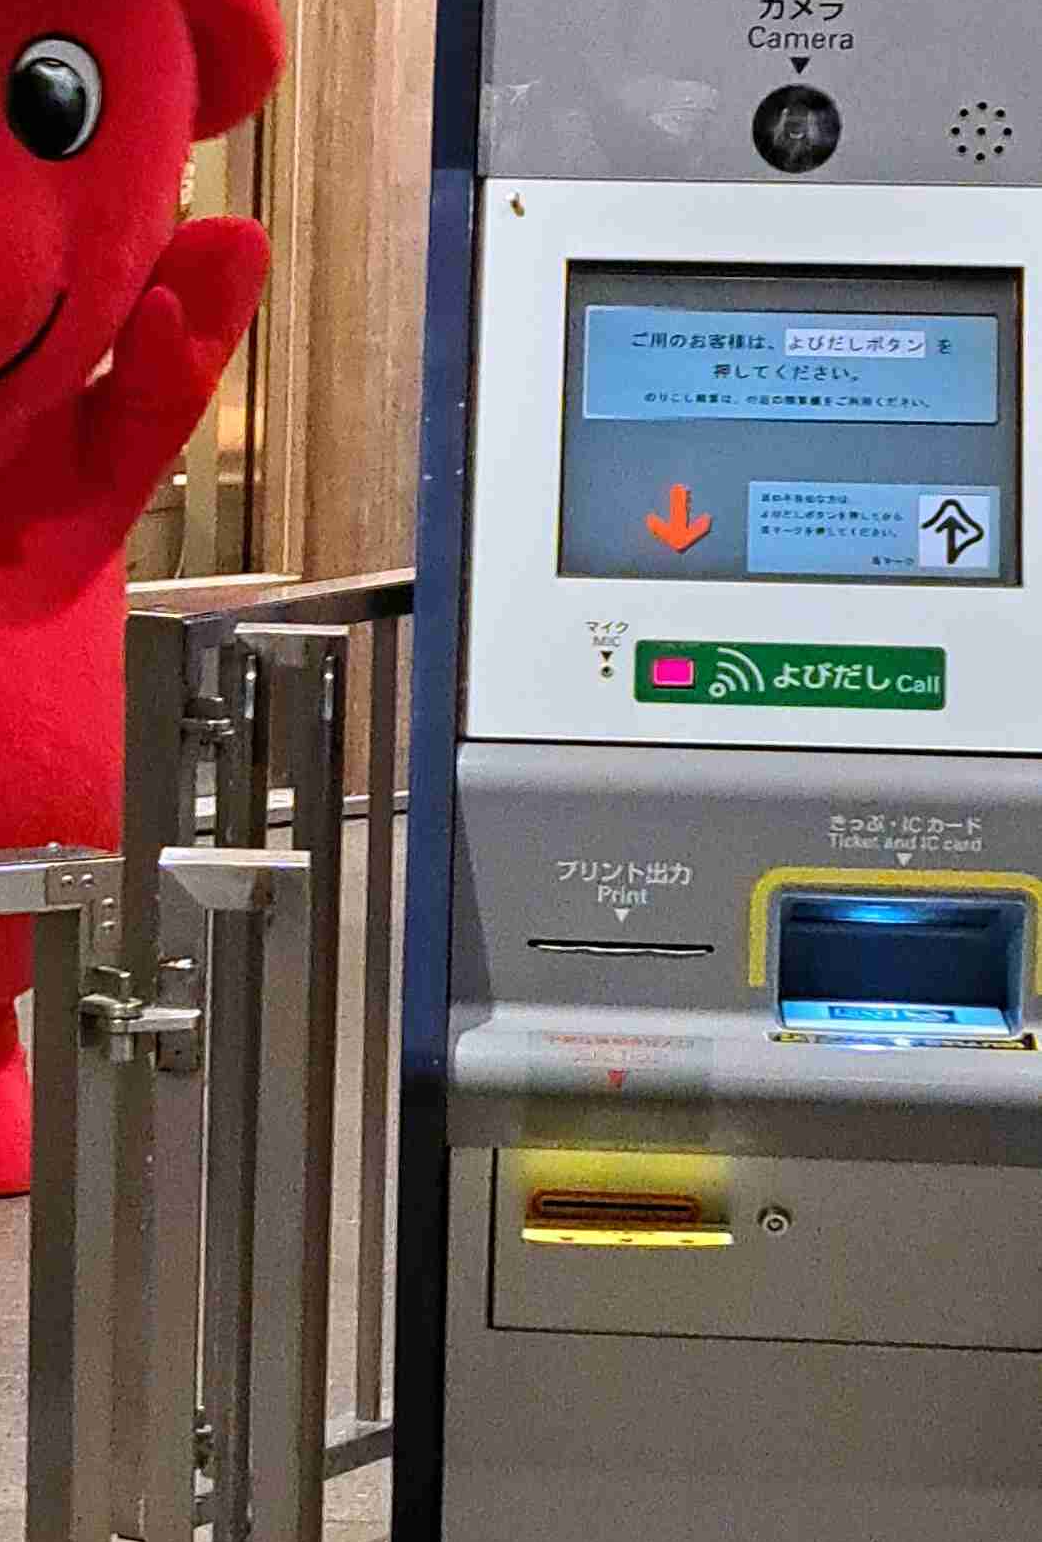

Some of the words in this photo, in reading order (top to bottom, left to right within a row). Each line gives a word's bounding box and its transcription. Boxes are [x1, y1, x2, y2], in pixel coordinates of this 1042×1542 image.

[748, 26, 855, 51] Camera
[789, 334, 924, 352] よびだしボタン
[937, 339, 952, 355] を
[713, 363, 860, 382] 押してください。
[587, 621, 629, 634] マイク
[773, 662, 890, 690] よびだし
[896, 674, 941, 694] Call
[829, 833, 878, 849] Ticket
[884, 835, 915, 850] and
[921, 836, 939, 851] IC
[944, 836, 981, 852] card
[558, 861, 693, 886] プリント出力
[598, 886, 647, 905] Print
